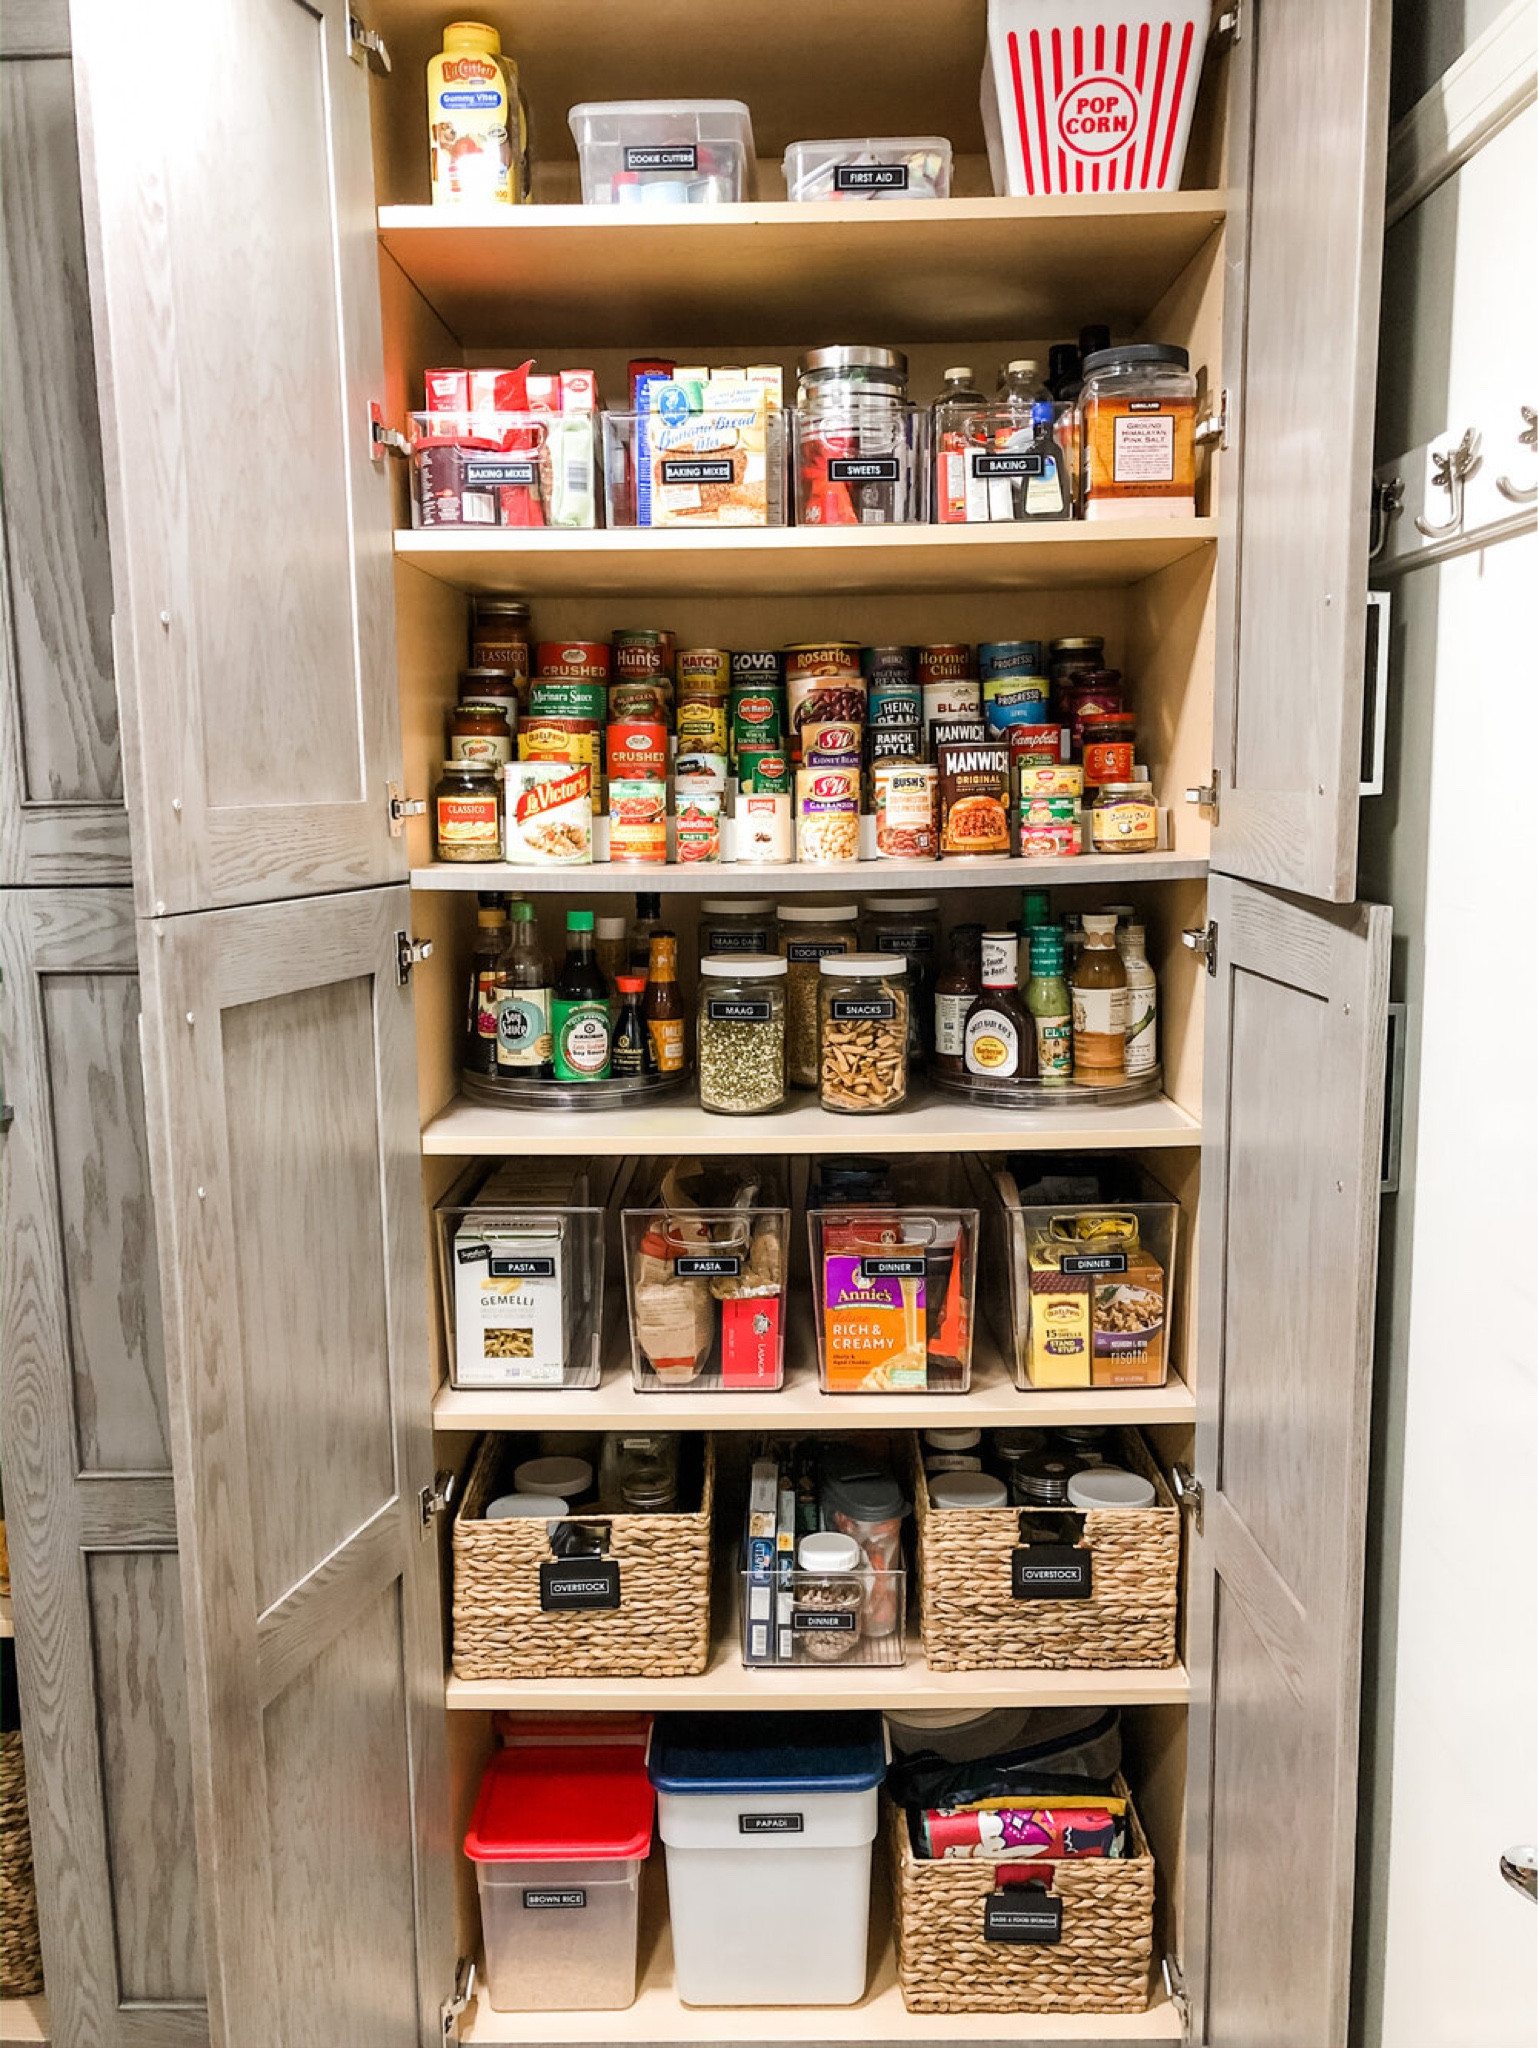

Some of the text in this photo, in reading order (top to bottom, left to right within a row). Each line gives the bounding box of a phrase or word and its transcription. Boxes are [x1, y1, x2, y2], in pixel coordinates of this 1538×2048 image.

[1076, 97, 1119, 115] POP
[1065, 115, 1128, 135] CORN
[628, 152, 694, 164] COOKIE CUTTERS
[849, 172, 893, 183] FIRST AID
[846, 465, 881, 475] SWEETS
[989, 460, 1027, 470] BAKING
[469, 468, 503, 479] BAKING
[666, 466, 730, 478] BAKING MIXES
[682, 655, 719, 668] HATCH
[733, 654, 776, 671] GOYA
[797, 648, 853, 668] Rosarita
[920, 651, 969, 665] Hormel
[993, 654, 1034, 669] PROGRESSO
[542, 665, 606, 677] CRUSHED
[930, 664, 961, 676] Chili
[569, 690, 593, 703] Sauce
[997, 690, 1039, 705] PROGRESSO
[883, 702, 916, 714] HEINZ
[876, 734, 911, 744] RANCH
[935, 725, 985, 744] MANWICH
[875, 744, 915, 756] STYLE
[612, 752, 665, 762] CRUSHED
[945, 751, 1010, 776] MANWICH
[955, 775, 1002, 785] ORIGINAL
[534, 773, 588, 809] Victoria
[448, 805, 485, 814] CLASSICO
[725, 1006, 754, 1016] MAAG
[846, 1005, 882, 1014] SNACKS
[508, 1263, 536, 1272] PASTA
[693, 1263, 722, 1271] PASTA
[878, 1263, 911, 1272] DINNER
[1078, 1260, 1111, 1268] DINNER
[480, 1295, 534, 1306] GEMELLI
[837, 1288, 893, 1303] Annie's
[832, 1324, 882, 1335] RICH &
[1046, 1329, 1057, 1338] 15
[832, 1338, 895, 1350] CREAMY
[1111, 1349, 1148, 1364] risotto
[1025, 1570, 1077, 1579] OVERSTOCK
[553, 1583, 605, 1592] OVERSTOCK
[529, 1895, 581, 1903] BROWN RICE
